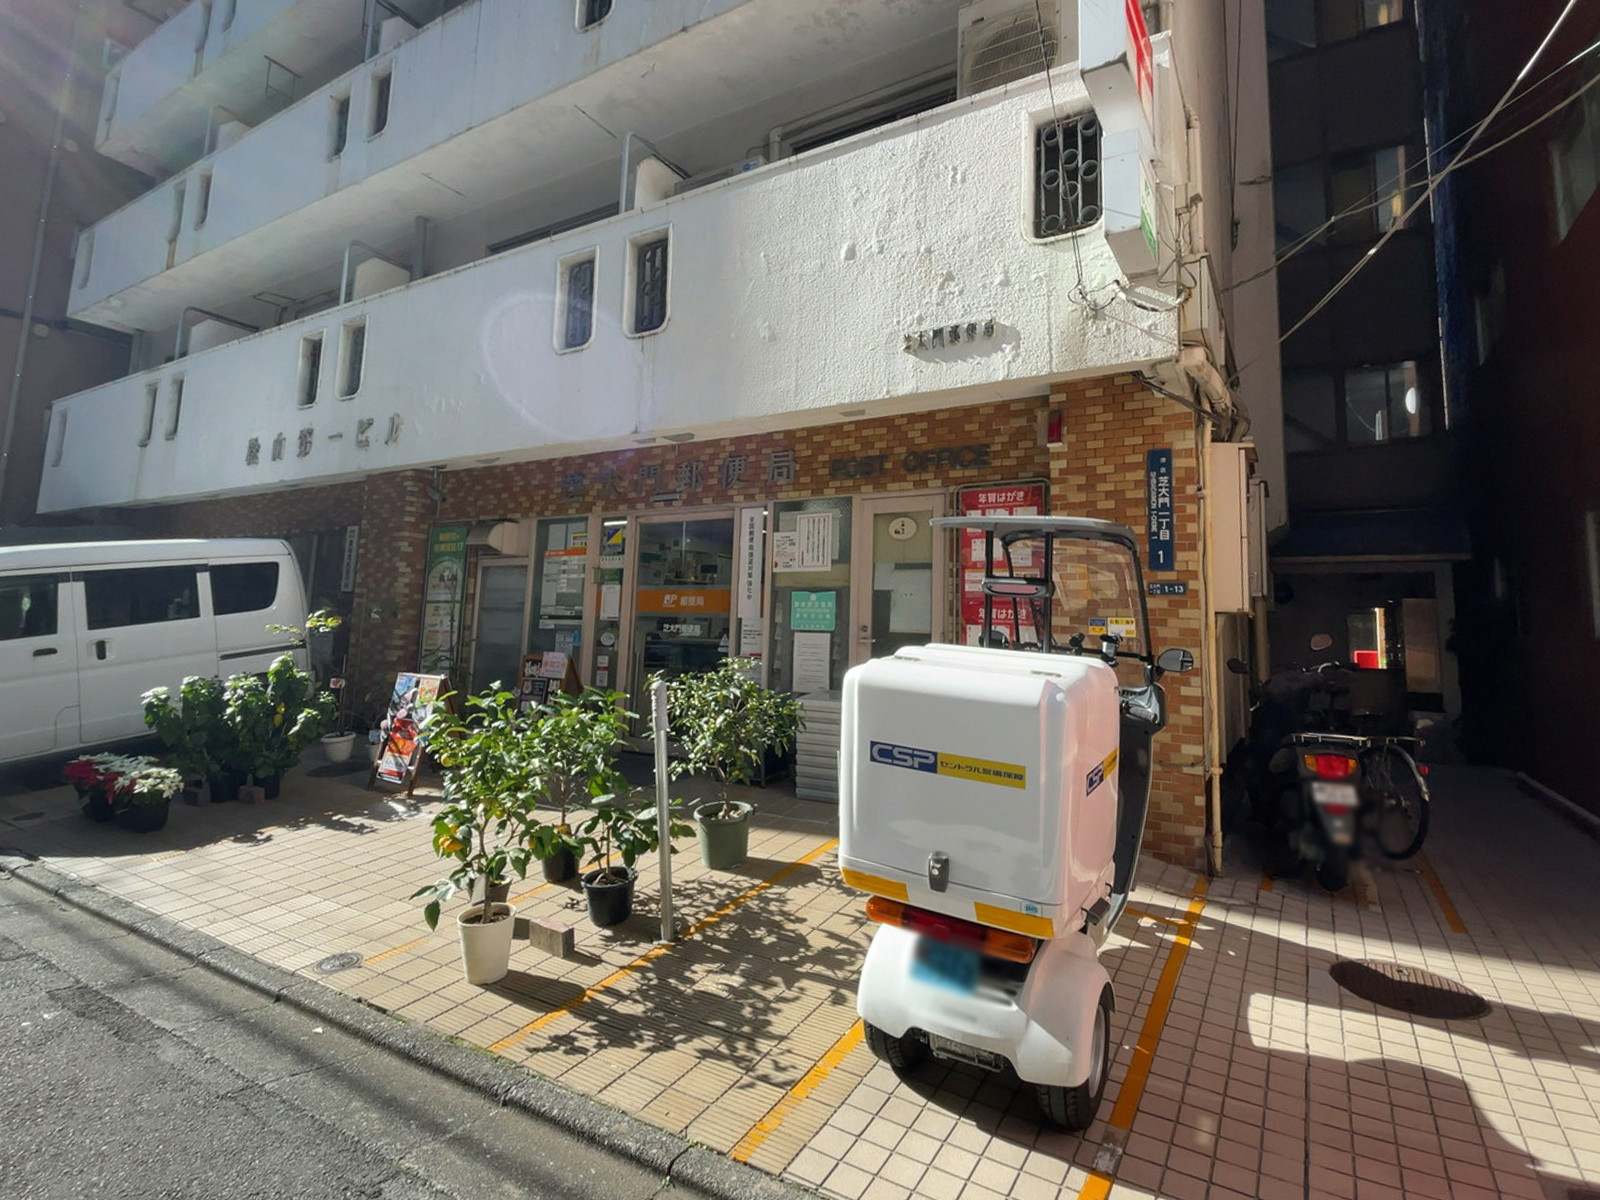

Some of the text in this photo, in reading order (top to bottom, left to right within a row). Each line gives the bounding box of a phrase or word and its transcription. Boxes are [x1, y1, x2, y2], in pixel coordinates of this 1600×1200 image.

[830, 444, 991, 480] POST OFFICE
[564, 449, 795, 502] 芝大門郵便局
[978, 490, 1025, 504] 年賀はがき
[1158, 476, 1170, 541] 芝大門一丁目
[1158, 550, 1164, 564] 1
[1164, 585, 1184, 594] 1-13
[871, 744, 936, 768] CSP
